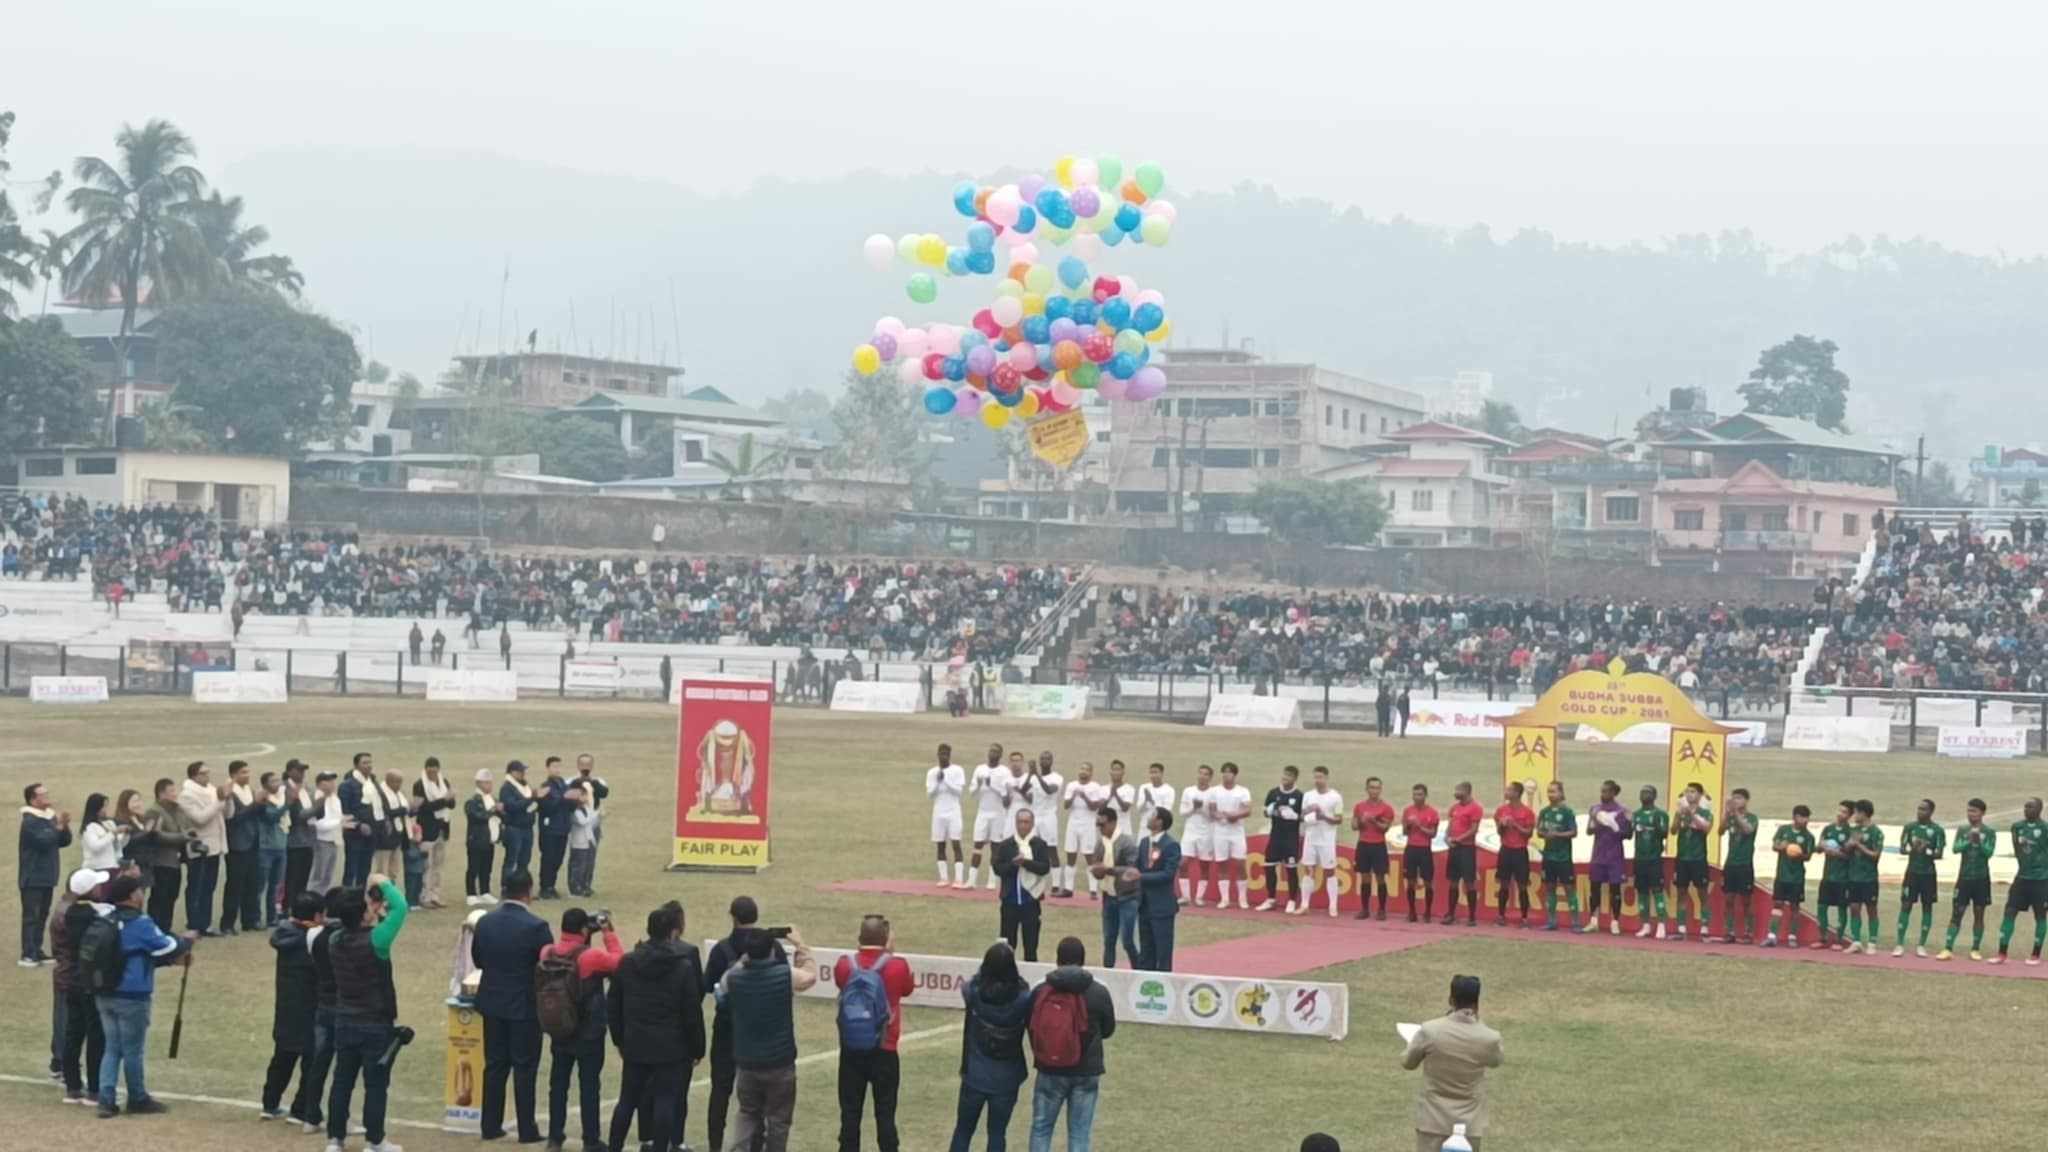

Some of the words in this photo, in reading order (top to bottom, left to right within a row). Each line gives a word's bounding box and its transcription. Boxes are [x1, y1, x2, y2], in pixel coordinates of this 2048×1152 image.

[1620, 693, 1664, 705] SUBBA
[1560, 703, 1597, 714] GOLD
[1601, 705, 1628, 715] CUP
[1454, 713, 1479, 726] Red
[680, 841, 715, 856] FAIR
[720, 842, 760, 858] PLAY
[913, 971, 966, 991] UBBA
